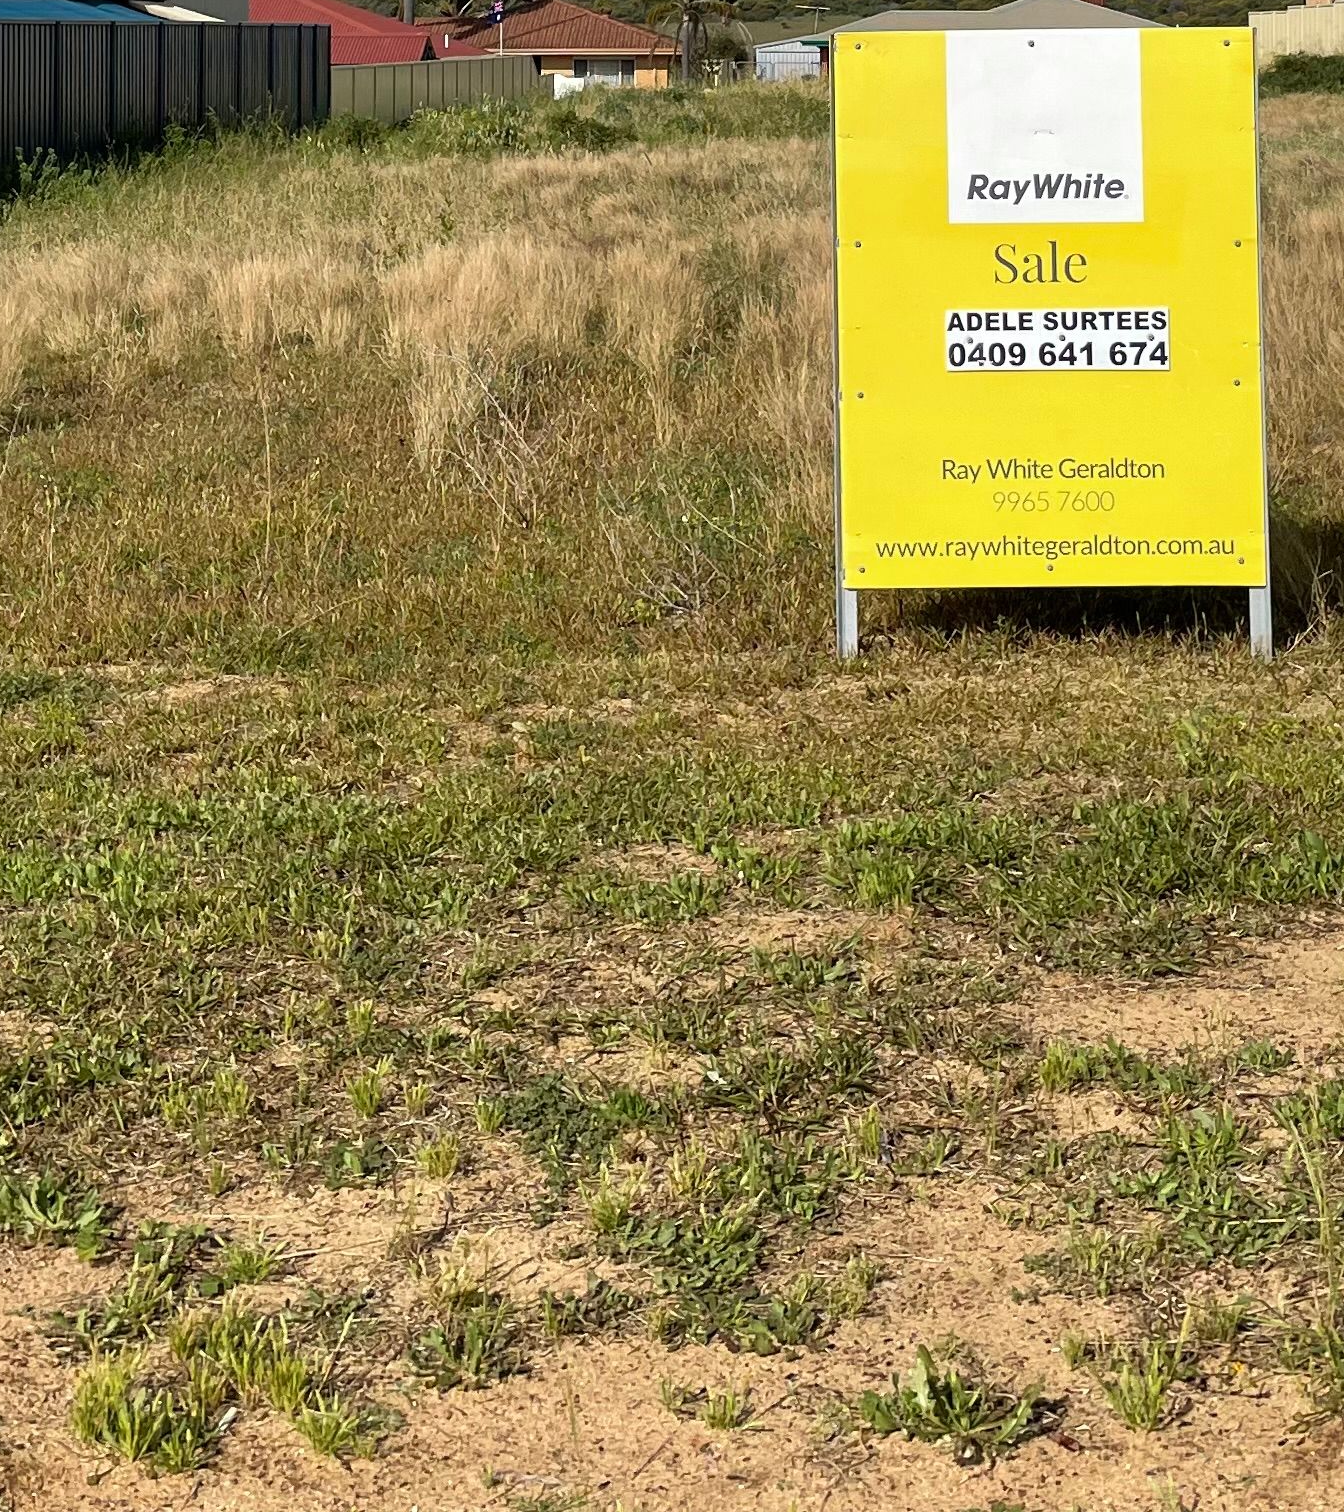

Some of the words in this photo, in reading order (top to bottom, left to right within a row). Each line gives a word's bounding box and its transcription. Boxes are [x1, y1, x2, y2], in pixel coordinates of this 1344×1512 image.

[994, 240, 1087, 284] Sale
[947, 312, 1034, 331] ADELE
[1043, 311, 1167, 331] SURTEES
[948, 342, 1026, 367] 0409
[1038, 341, 1093, 366] 641
[1109, 341, 1168, 366] 674
[942, 459, 981, 484] Ray
[986, 458, 1053, 479] White
[1058, 458, 1165, 479] Geraldton
[992, 491, 1049, 513] 9965
[1057, 490, 1115, 512] 7600
[875, 535, 1235, 561] www.raywhitegeraldton.com.au
